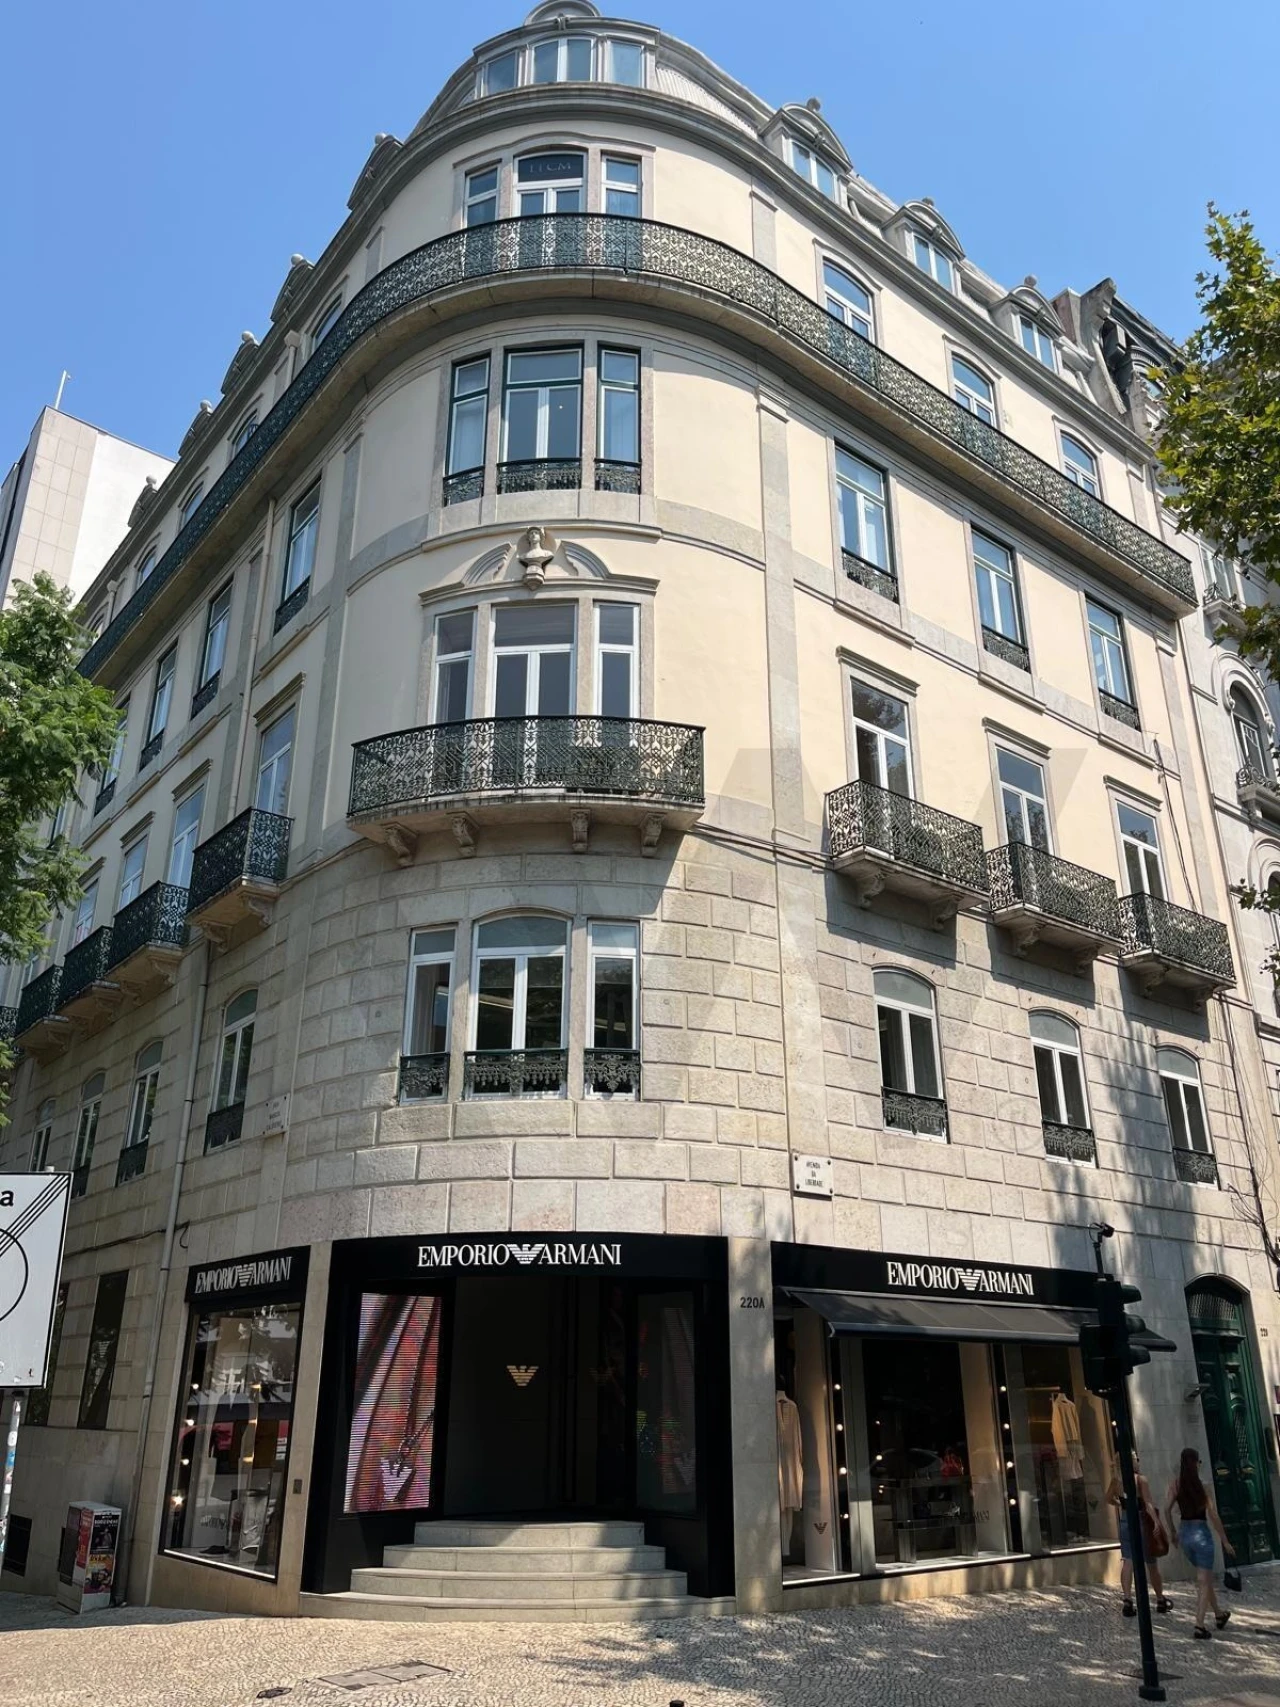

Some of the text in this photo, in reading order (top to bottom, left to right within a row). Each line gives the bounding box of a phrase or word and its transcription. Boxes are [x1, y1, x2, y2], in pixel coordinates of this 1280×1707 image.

[417, 1244, 622, 1267] EMPORIO ARMANI
[194, 1256, 293, 1294] EMPORIO ARMANI
[886, 1261, 1035, 1296] EMPORIO ARMANI
[740, 1296, 765, 1309] 220A
